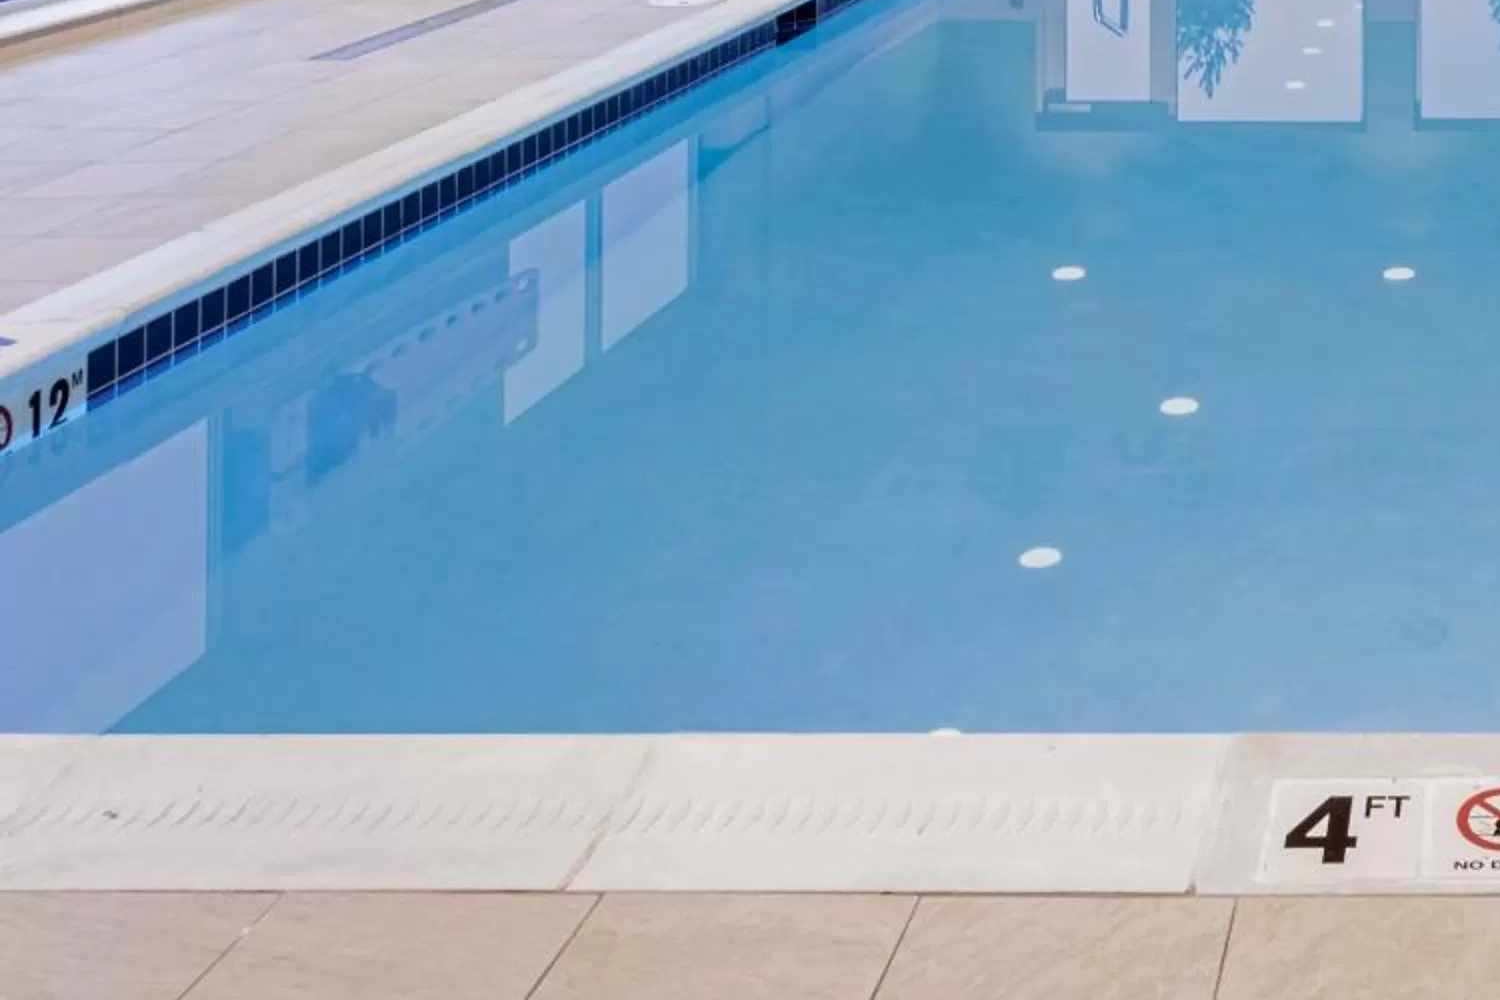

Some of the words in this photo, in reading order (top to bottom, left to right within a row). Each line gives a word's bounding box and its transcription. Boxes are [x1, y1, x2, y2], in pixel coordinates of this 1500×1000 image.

[1284, 795, 1358, 864] 4
[1364, 795, 1411, 818] FT
[1453, 860, 1485, 870] NO
